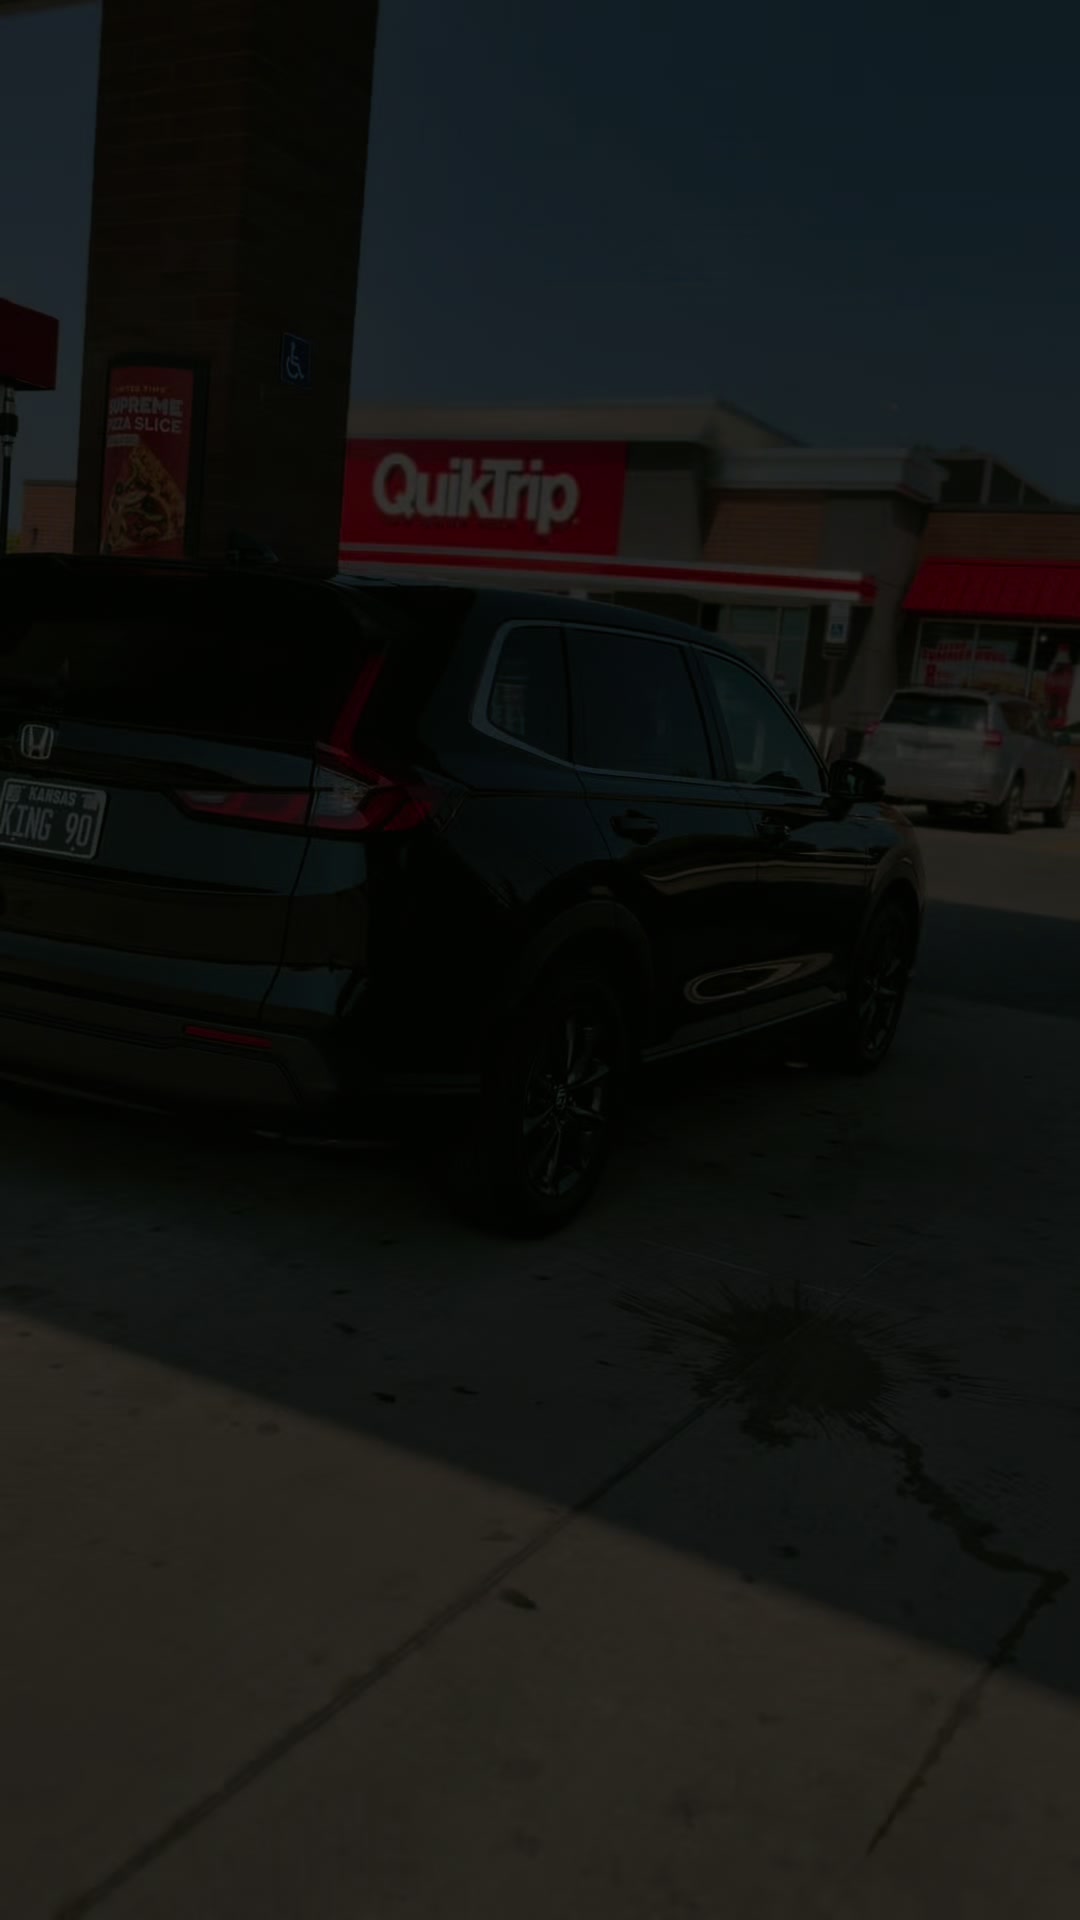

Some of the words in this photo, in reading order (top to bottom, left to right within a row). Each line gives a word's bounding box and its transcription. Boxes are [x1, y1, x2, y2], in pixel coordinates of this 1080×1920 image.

[134, 417, 183, 434] SLICE
[373, 452, 580, 535] QuikTrip
[28, 785, 77, 806] KANSAS
[0, 803, 54, 841] KING
[64, 812, 93, 847] 90
